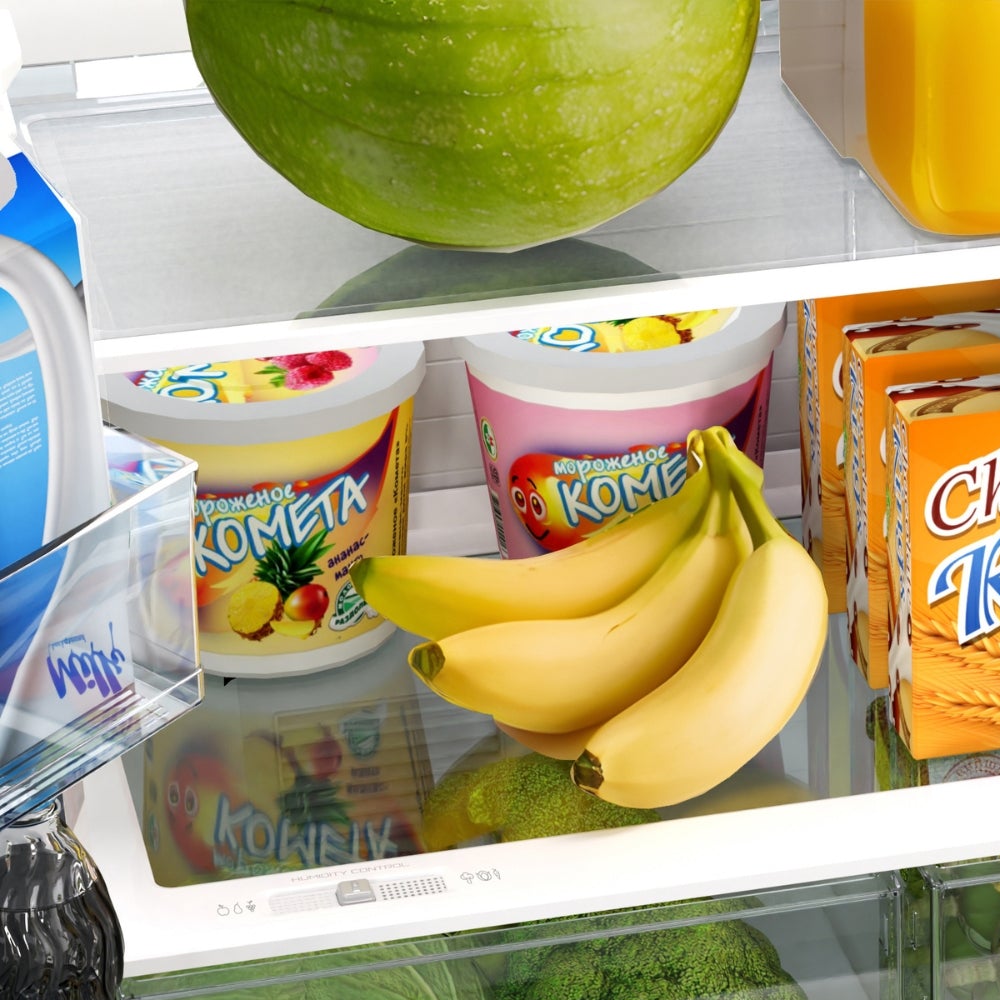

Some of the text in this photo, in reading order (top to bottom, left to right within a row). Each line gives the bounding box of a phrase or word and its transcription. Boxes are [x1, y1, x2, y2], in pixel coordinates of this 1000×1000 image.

[554, 446, 669, 484] мороженое
[194, 483, 297, 527] ороженое
[557, 452, 687, 527] КОМЕ
[194, 472, 370, 577] КОМЕТА
[327, 533, 370, 569] ананас-
[291, 862, 411, 883] HUMIDITY CONTROL
